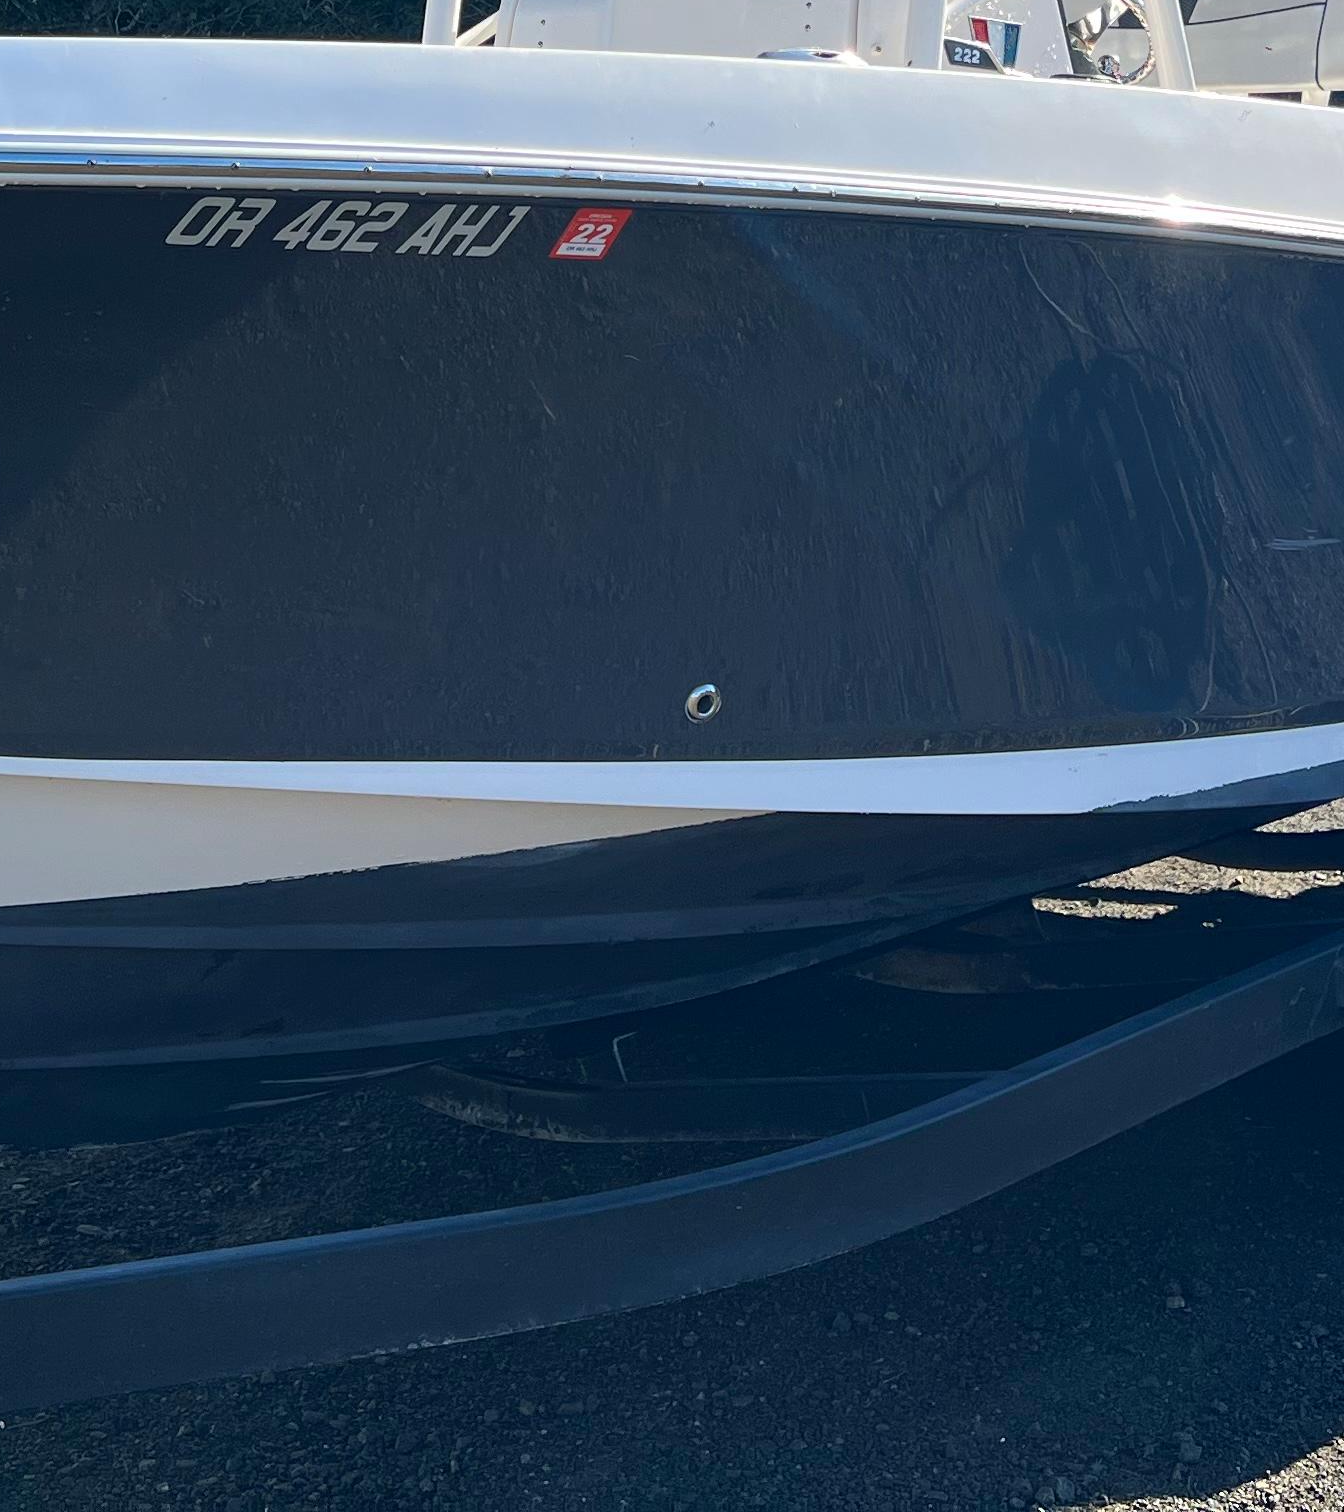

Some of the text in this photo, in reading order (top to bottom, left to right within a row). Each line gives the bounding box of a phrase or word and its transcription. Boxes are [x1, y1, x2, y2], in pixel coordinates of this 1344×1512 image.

[954, 46, 981, 64] 222
[164, 195, 532, 258] OR 462 AHJ
[569, 222, 614, 244] 22
